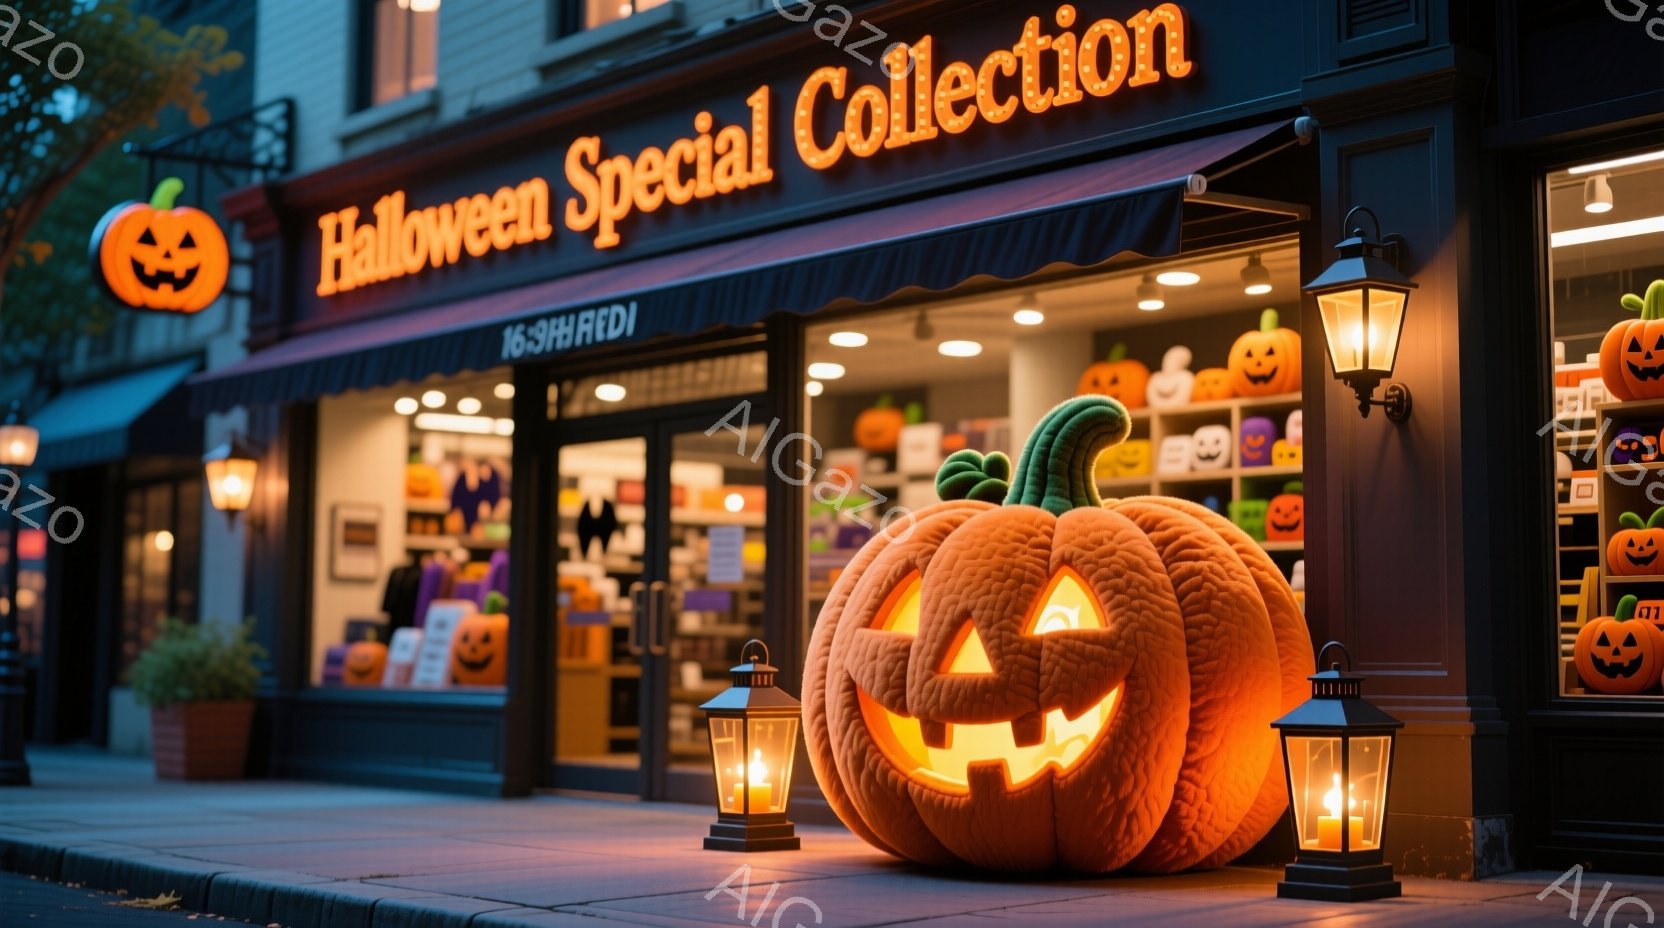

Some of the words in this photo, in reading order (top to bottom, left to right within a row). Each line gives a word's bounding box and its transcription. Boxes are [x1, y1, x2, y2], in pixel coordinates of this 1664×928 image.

[316, 177, 552, 296] Halloween
[565, 85, 773, 249] Special
[794, 3, 1192, 170] Collection
